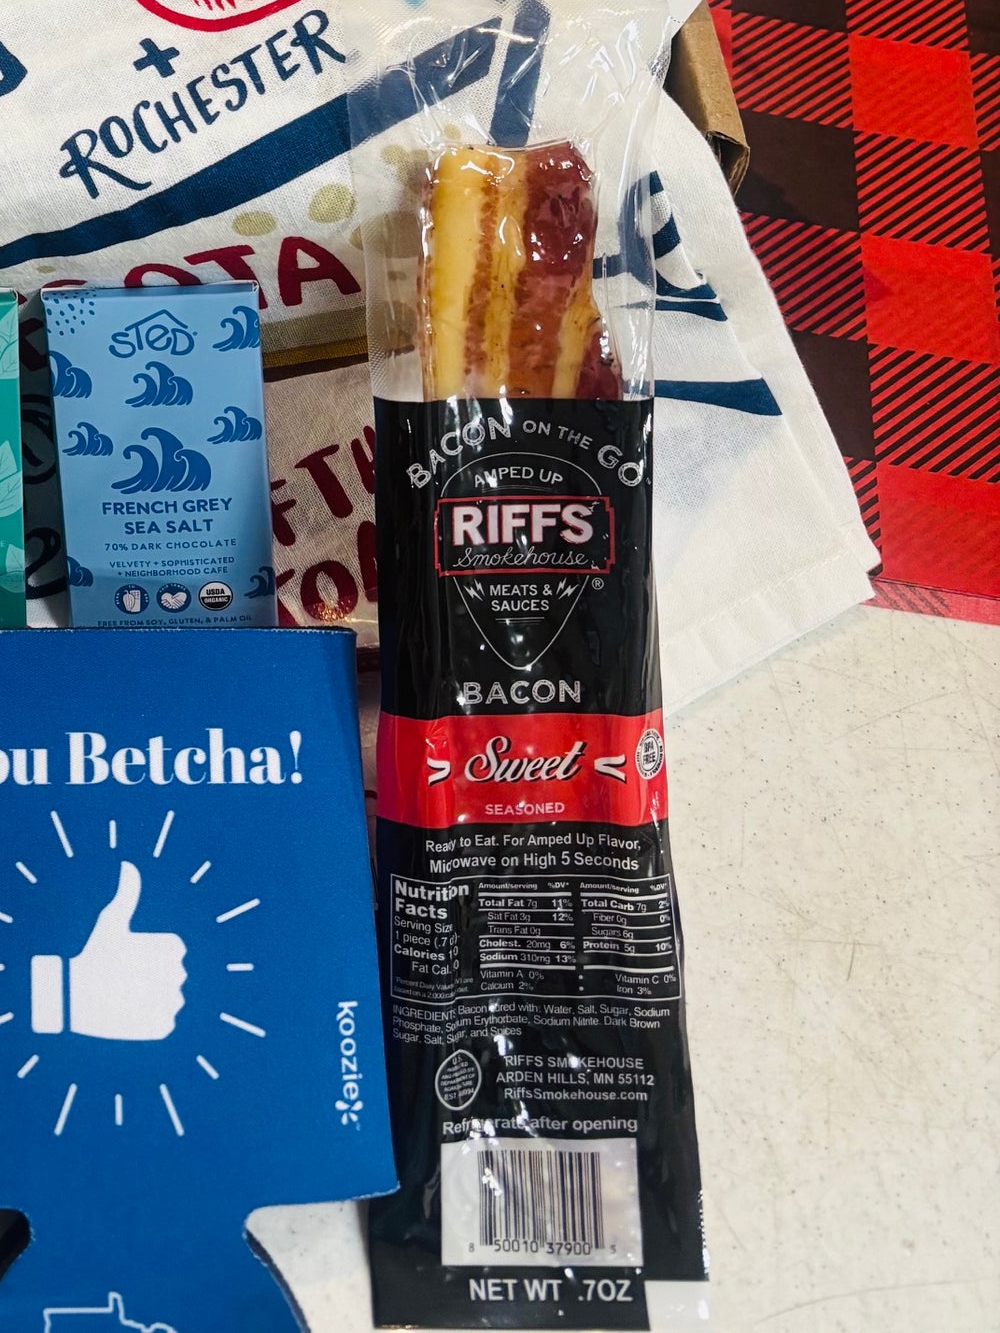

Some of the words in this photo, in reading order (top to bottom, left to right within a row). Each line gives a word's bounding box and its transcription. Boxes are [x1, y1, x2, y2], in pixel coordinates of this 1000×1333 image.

[60, 8, 347, 200] ROCHESTER
[406, 417, 512, 489] BACON
[523, 419, 551, 436] ON
[558, 426, 593, 450] THE
[597, 444, 643, 487] GO
[538, 468, 563, 485] UP
[102, 501, 178, 515] FRENCH
[183, 498, 233, 513] GREY
[124, 521, 161, 534] SEA
[166, 519, 213, 533] SALT
[452, 504, 594, 546] RIFFS
[105, 543, 128, 551] 70%
[131, 542, 162, 550] DARK
[166, 539, 236, 550] CHOCOLATE
[490, 584, 537, 596] MEATS
[542, 584, 552, 596] &
[491, 600, 550, 612] SAUCES
[463, 679, 581, 705] BACON
[65, 728, 303, 787] Betcha!
[464, 735, 588, 783] Sweet
[527, 835, 571, 847] Amped
[501, 856, 518, 866] on
[524, 854, 556, 869] High
[573, 854, 639, 870] Seconds
[395, 899, 448, 919] Facts
[336, 1000, 359, 1100] koozie
[496, 1073, 543, 1084] ARDEN
[594, 1073, 613, 1085] MN
[617, 1073, 655, 1086] 55112
[572, 1118, 638, 1135] opening
[546, 1241, 591, 1256] 37900
[469, 1279, 518, 1301] NET
[524, 1280, 562, 1301] WT
